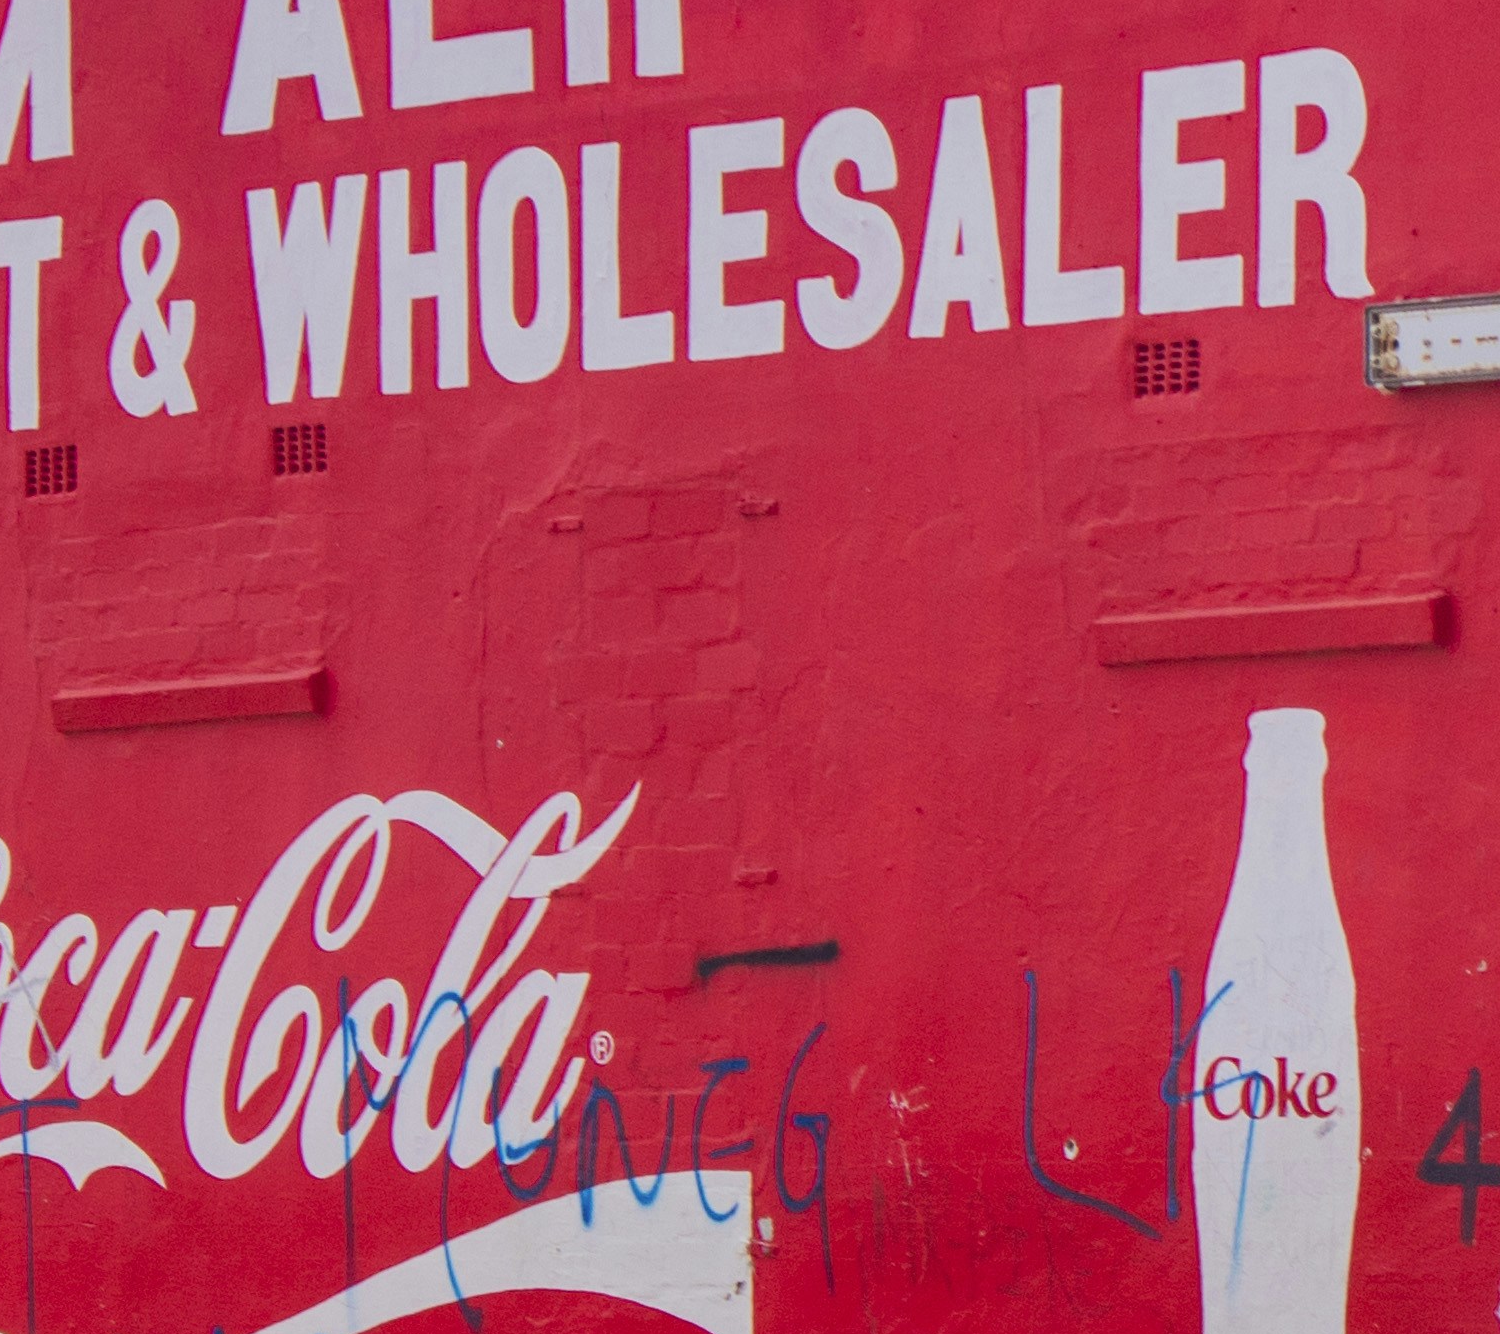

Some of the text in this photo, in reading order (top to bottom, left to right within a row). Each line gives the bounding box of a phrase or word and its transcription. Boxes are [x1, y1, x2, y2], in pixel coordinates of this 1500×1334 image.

[107, 198, 197, 418] &
[245, 47, 1376, 405] WHOLESALER
[1202, 1056, 1338, 1121] Coke
